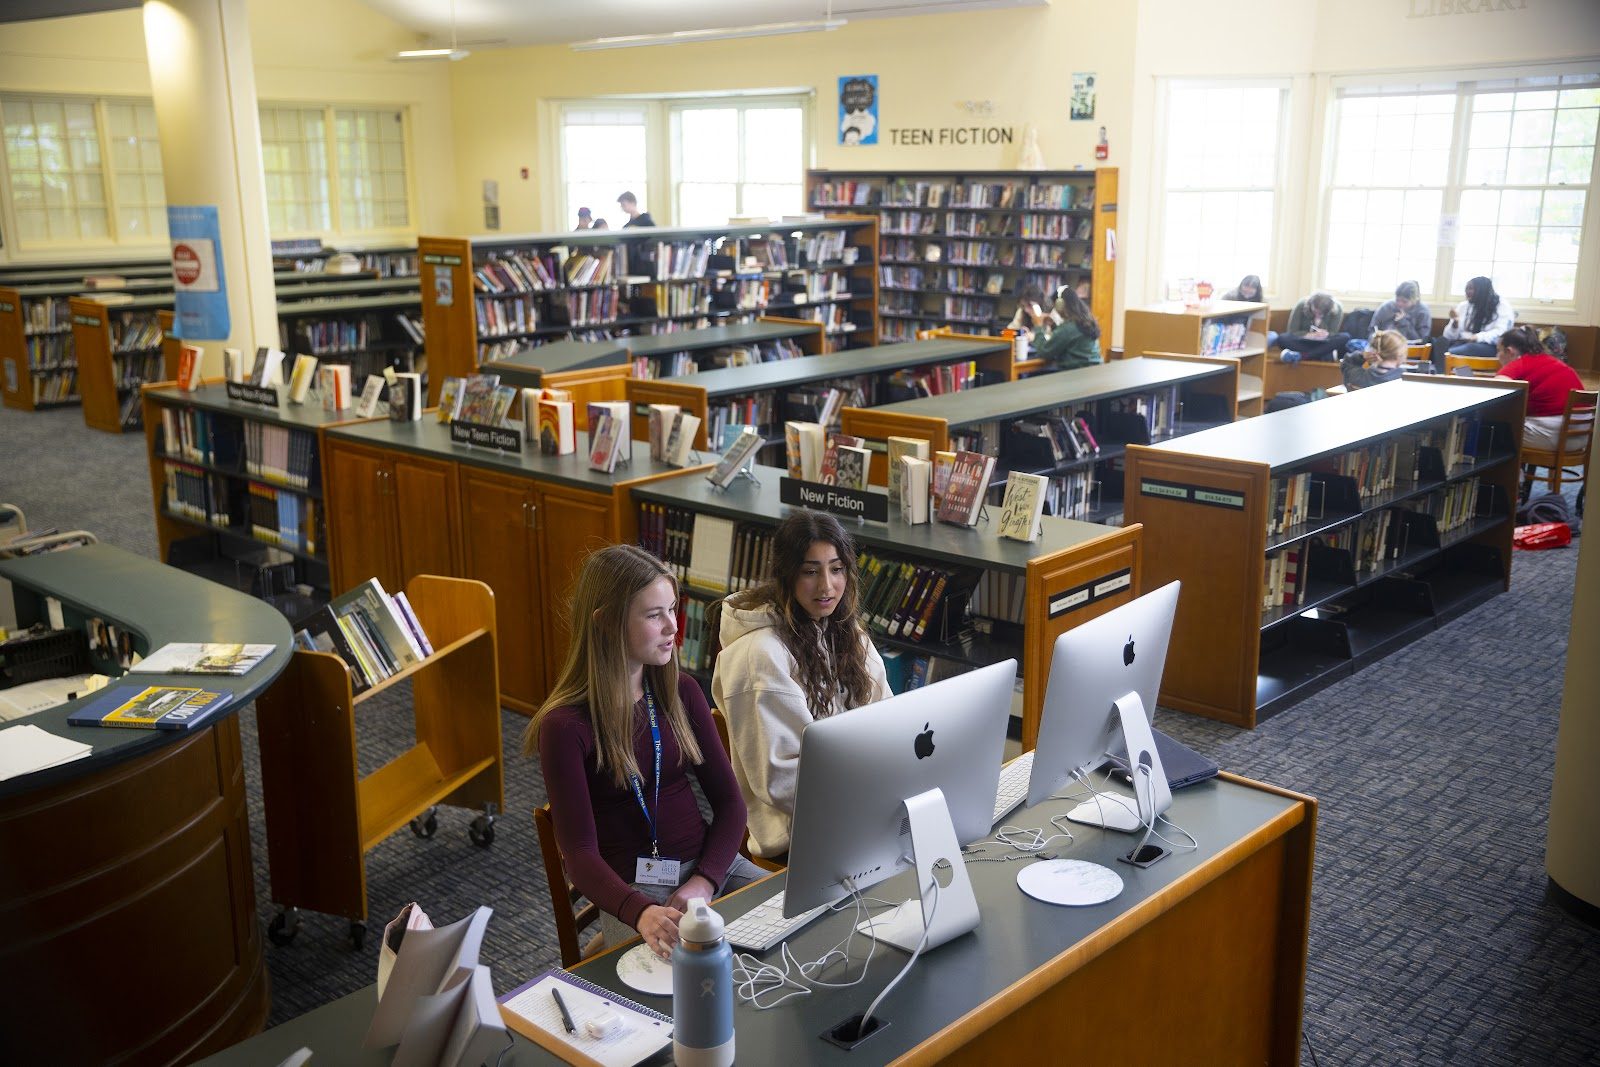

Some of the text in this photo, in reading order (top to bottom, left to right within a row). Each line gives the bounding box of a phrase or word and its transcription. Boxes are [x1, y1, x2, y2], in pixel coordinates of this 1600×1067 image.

[889, 128, 1013, 145] TEEN FICTION
[453, 426, 516, 447] New Teen Fiction
[954, 461, 983, 477] VIOLIN
[800, 487, 864, 511] New Fiction
